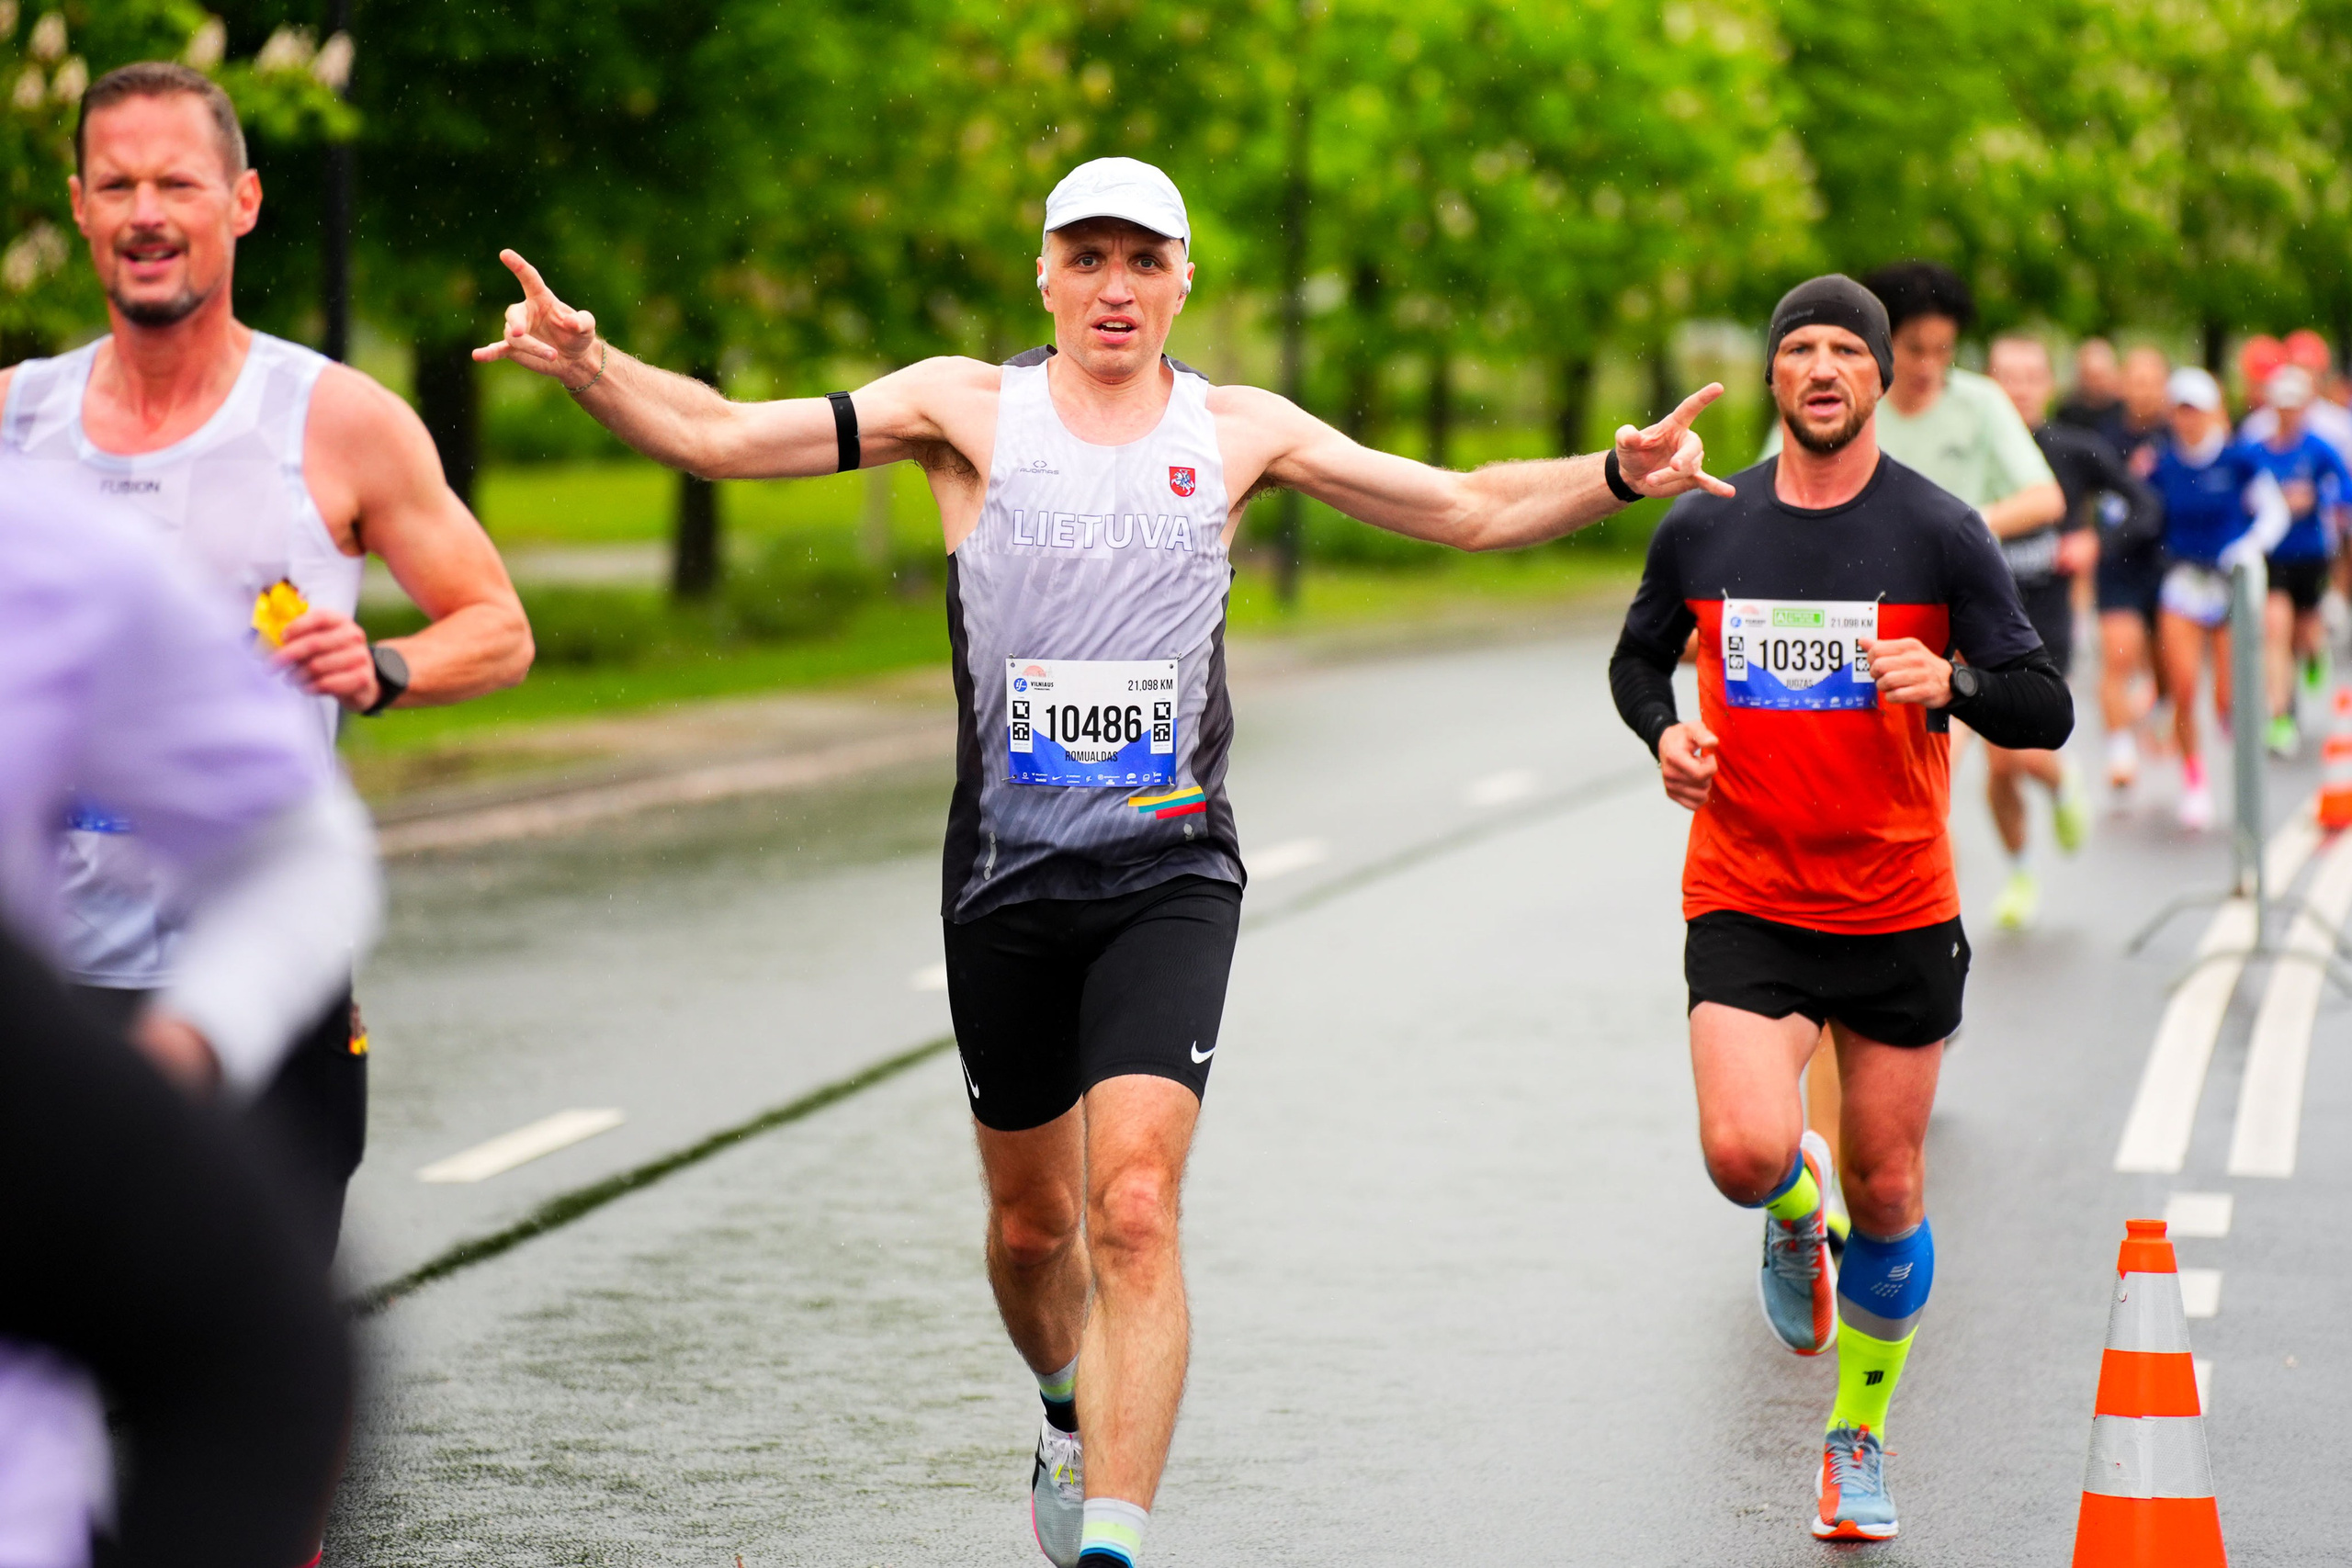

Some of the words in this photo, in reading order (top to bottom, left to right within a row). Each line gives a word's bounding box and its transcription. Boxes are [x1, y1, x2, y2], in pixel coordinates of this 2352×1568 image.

[1012, 509, 1194, 552] LIETUVA
[1860, 617, 1874, 628] KM
[1758, 638, 1843, 671] 10339
[1127, 679, 1159, 692] 21,098
[1159, 678, 1173, 690] KM
[1046, 704, 1142, 743] 10486
[1065, 750, 1118, 762] ROMUALDAS
